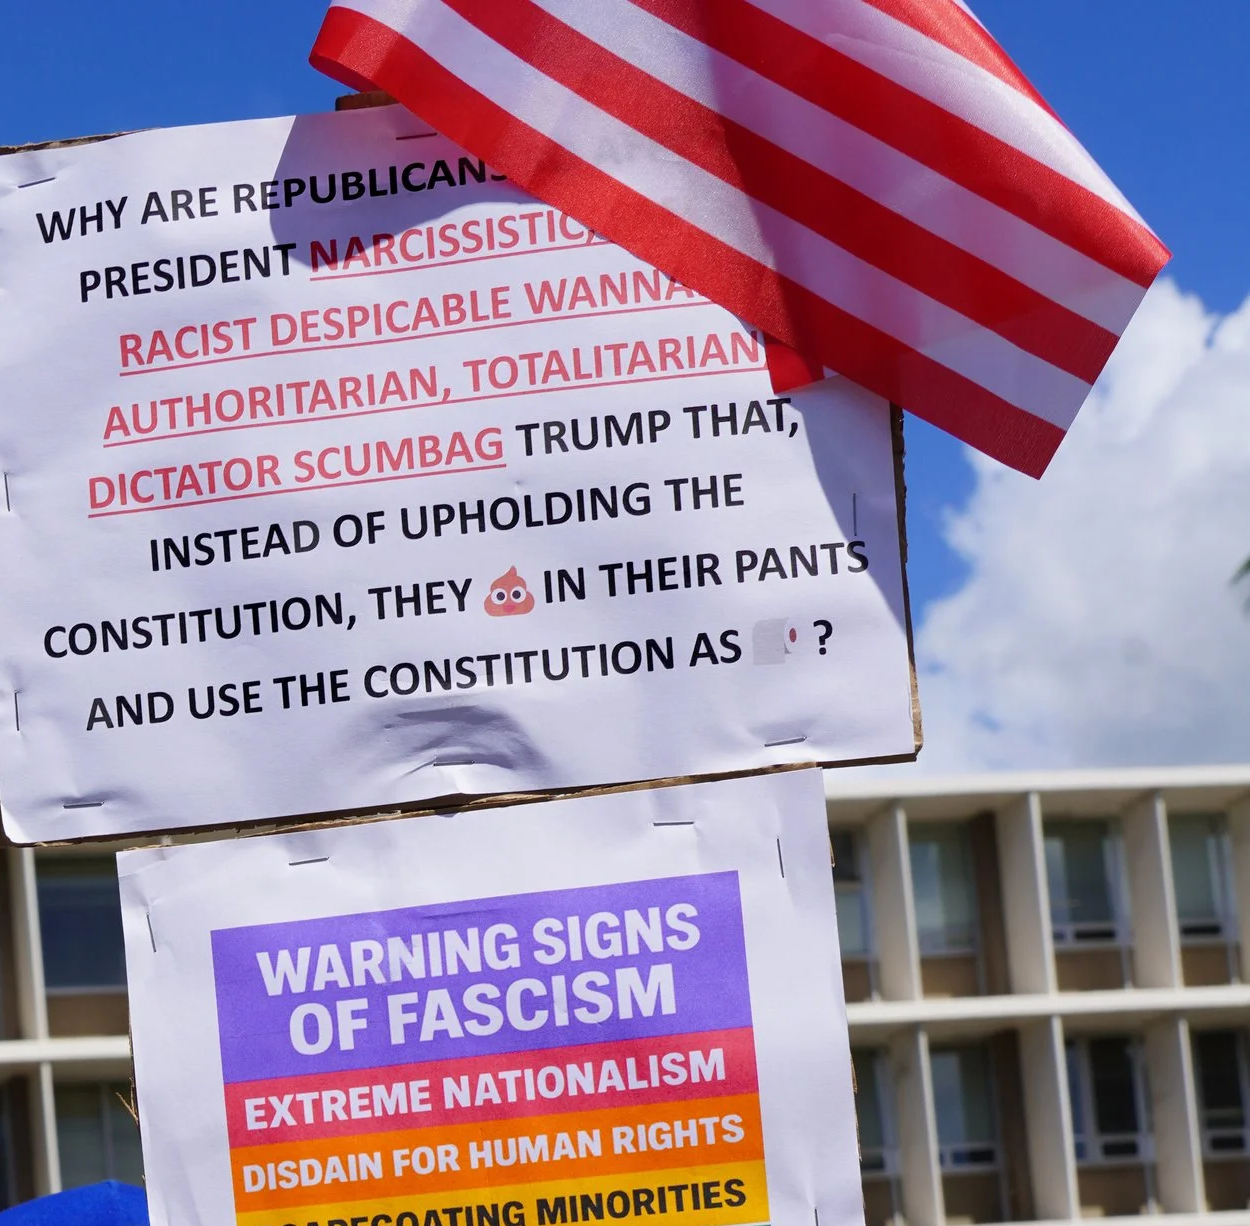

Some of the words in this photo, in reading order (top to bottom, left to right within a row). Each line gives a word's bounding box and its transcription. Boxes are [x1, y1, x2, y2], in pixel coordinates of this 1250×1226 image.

[36, 196, 128, 244] WHY
[141, 187, 218, 225] ARE
[233, 155, 507, 213] REPUBLICAN
[80, 242, 297, 303] PRESIDENT
[120, 317, 257, 367] RACIST
[271, 286, 511, 346] DESPICABLE
[103, 366, 452, 439] AUTHORITARIAN,
[89, 455, 281, 509] DICTATOR
[294, 428, 503, 483] SCUMBAG
[515, 410, 671, 456] TRUMP
[683, 400, 798, 439] THAT,
[150, 520, 320, 571] INSTEAD
[333, 511, 385, 547] OF
[401, 482, 651, 540] UPHOLDING
[664, 473, 744, 511] THE
[44, 592, 356, 658] CONSTITUTION,
[368, 578, 472, 620] THEY
[544, 567, 586, 603] IN
[598, 553, 722, 597] THEIR
[736, 540, 869, 583] PANTS
[86, 692, 174, 731] AND
[188, 680, 263, 719] USE
[273, 669, 350, 709] THE
[364, 637, 674, 698] CONSTITUTION
[689, 629, 742, 667] AS
[813, 619, 833, 655] ?
[256, 924, 520, 995] WARNING
[533, 904, 700, 964] SIGNS
[290, 998, 368, 1054] OF
[388, 964, 676, 1044] FASCISM
[246, 1080, 431, 1129] EXTREME
[444, 1048, 725, 1108] NATIONALISM
[244, 1153, 382, 1192] DISDAIN
[394, 1145, 459, 1175] FOR
[470, 1130, 601, 1168] HUMAN
[613, 1115, 744, 1153] RIGHTS
[537, 1179, 745, 1225] MINORITIES
